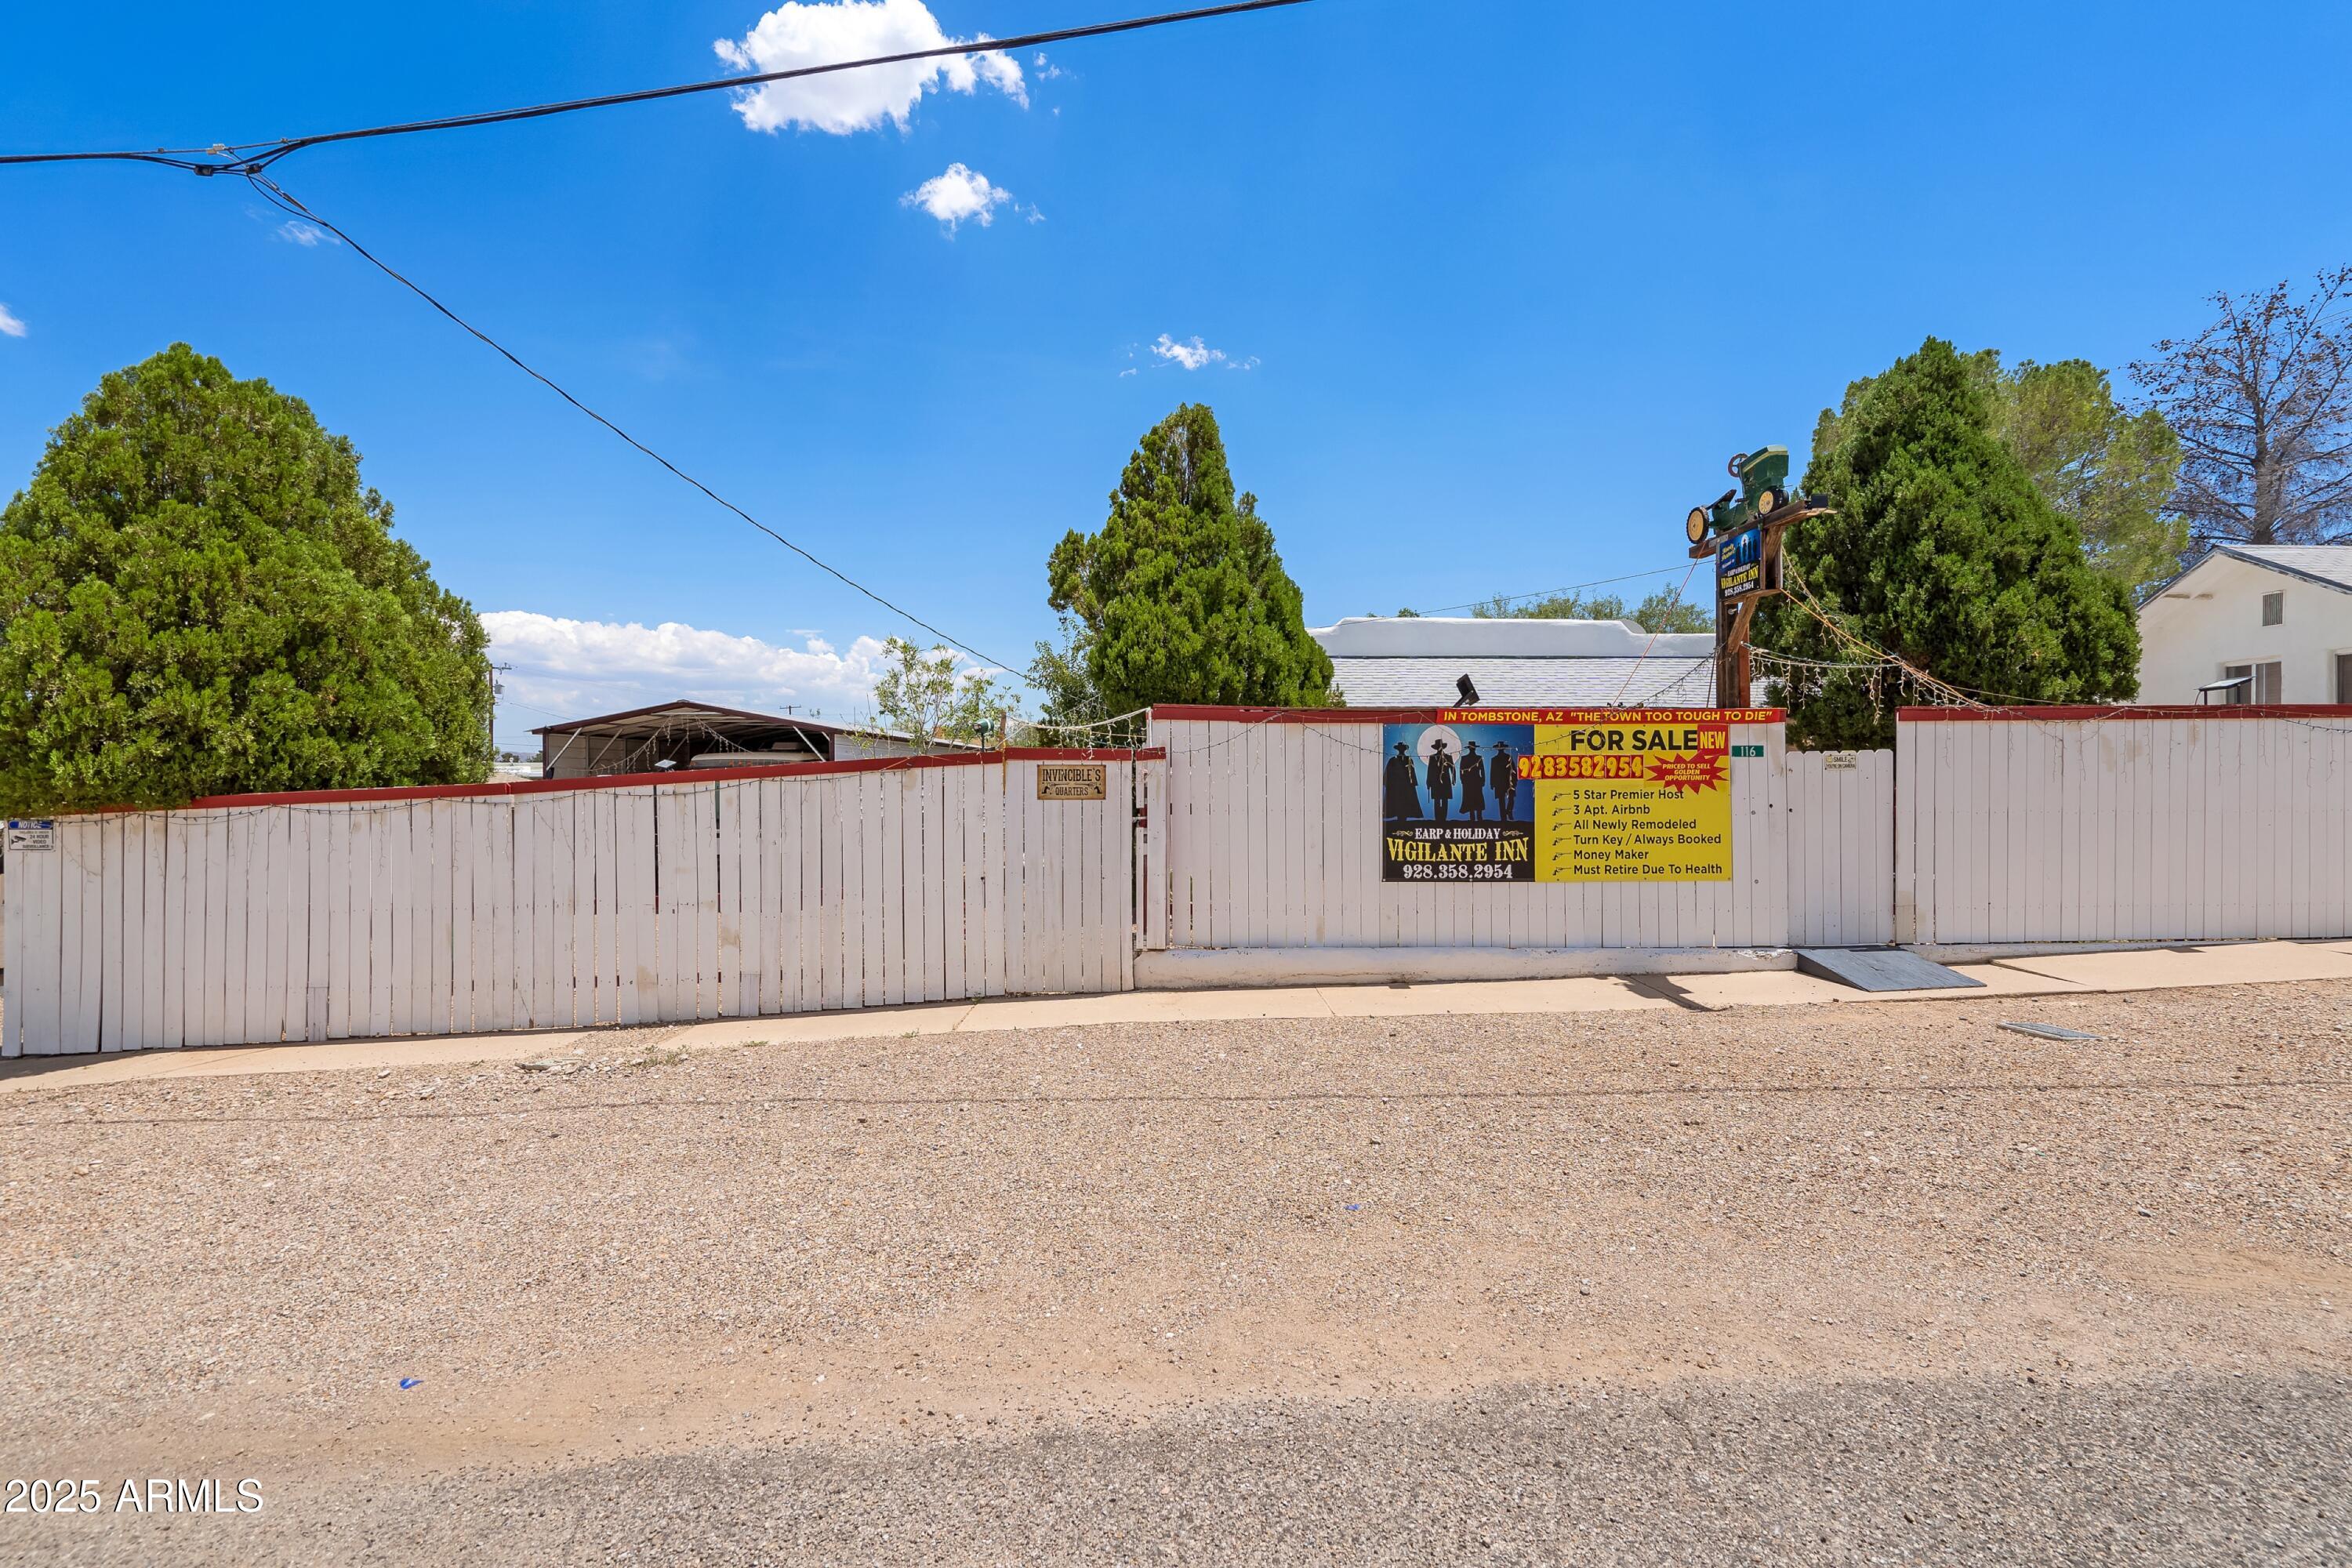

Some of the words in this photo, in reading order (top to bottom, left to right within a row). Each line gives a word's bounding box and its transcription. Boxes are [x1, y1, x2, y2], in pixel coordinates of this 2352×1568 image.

[1748, 564, 1759, 581] INN
[1443, 711, 1457, 721] IN
[1461, 711, 1542, 722] TOMBSTONE,
[1545, 711, 1563, 721] AZ
[1570, 712, 1601, 721] "THE
[1604, 712, 1642, 721] TOWN
[1646, 711, 1672, 721] TOO
[1677, 711, 1720, 721] TOUGH
[1725, 711, 1741, 721] TO
[1744, 710, 1772, 720] DIE"
[1570, 730, 1624, 751] FOR
[1632, 730, 1697, 751] SALE
[1700, 731, 1726, 750] NEW
[1740, 746, 1756, 757] 116
[1519, 755, 1643, 778] 9283582954
[1043, 768, 1101, 782] INVINCIBLE'S
[1055, 786, 1088, 796] QUARTERS
[1573, 790, 1580, 800] 5
[1584, 790, 1606, 800] Star
[1610, 789, 1654, 800] Premier
[1658, 789, 1684, 799] Host
[1573, 805, 1580, 815] 3
[1584, 805, 1607, 817] Apt.
[1611, 804, 1650, 815] Airbnb
[1573, 820, 1589, 829] All
[1592, 819, 1628, 831] Newly
[1632, 819, 1697, 829] Remodeled
[1414, 828, 1444, 840] EARP
[1445, 829, 1451, 839] &
[1453, 828, 1501, 840] HOLIDAY
[1573, 835, 1599, 844] Turn
[1602, 834, 1623, 846] Key
[1625, 833, 1632, 846] /
[1634, 834, 1674, 846] Always
[1678, 834, 1721, 844] Booked
[1386, 837, 1487, 862] VIGILANTE
[1494, 837, 1529, 862] INN
[1573, 850, 1611, 861] Money
[1615, 850, 1649, 859] Maker
[1403, 864, 1513, 879] 928.358.2954
[1573, 865, 1601, 875] Must
[1604, 865, 1639, 874] Retire
[1642, 865, 1665, 874] Due
[1668, 865, 1682, 874] To
[1686, 864, 1722, 874] Health
